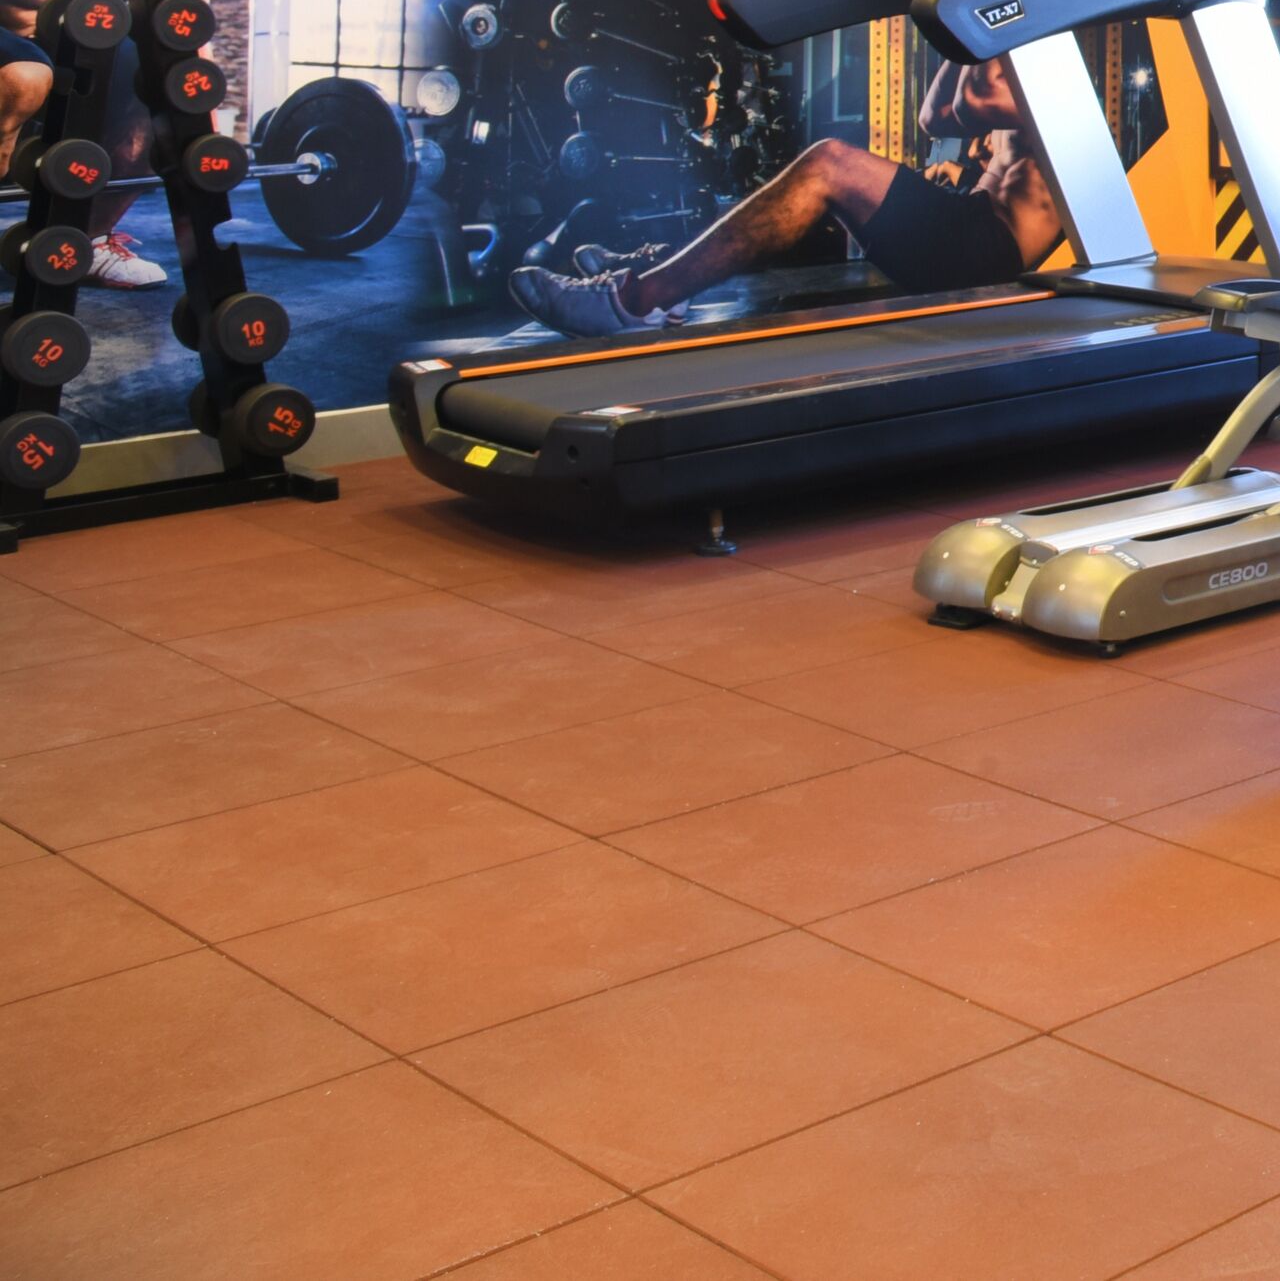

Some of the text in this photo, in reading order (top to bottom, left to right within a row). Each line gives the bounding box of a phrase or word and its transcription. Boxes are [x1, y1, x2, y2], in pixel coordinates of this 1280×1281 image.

[84, 12, 115, 29] 2.5
[174, 9, 197, 37] 2.5
[986, 2, 1018, 23] TT-X7
[183, 75, 212, 97] 2.5
[68, 161, 88, 178] 5
[201, 156, 211, 172] KG
[211, 157, 229, 170] 5
[48, 242, 76, 269] 2.5
[241, 320, 266, 339] 10
[39, 338, 63, 363] 10
[248, 336, 264, 347] KG
[32, 353, 48, 368] KG
[267, 406, 294, 436] 15
[21, 438, 55, 470] 15
[1208, 561, 1268, 590] CE800
